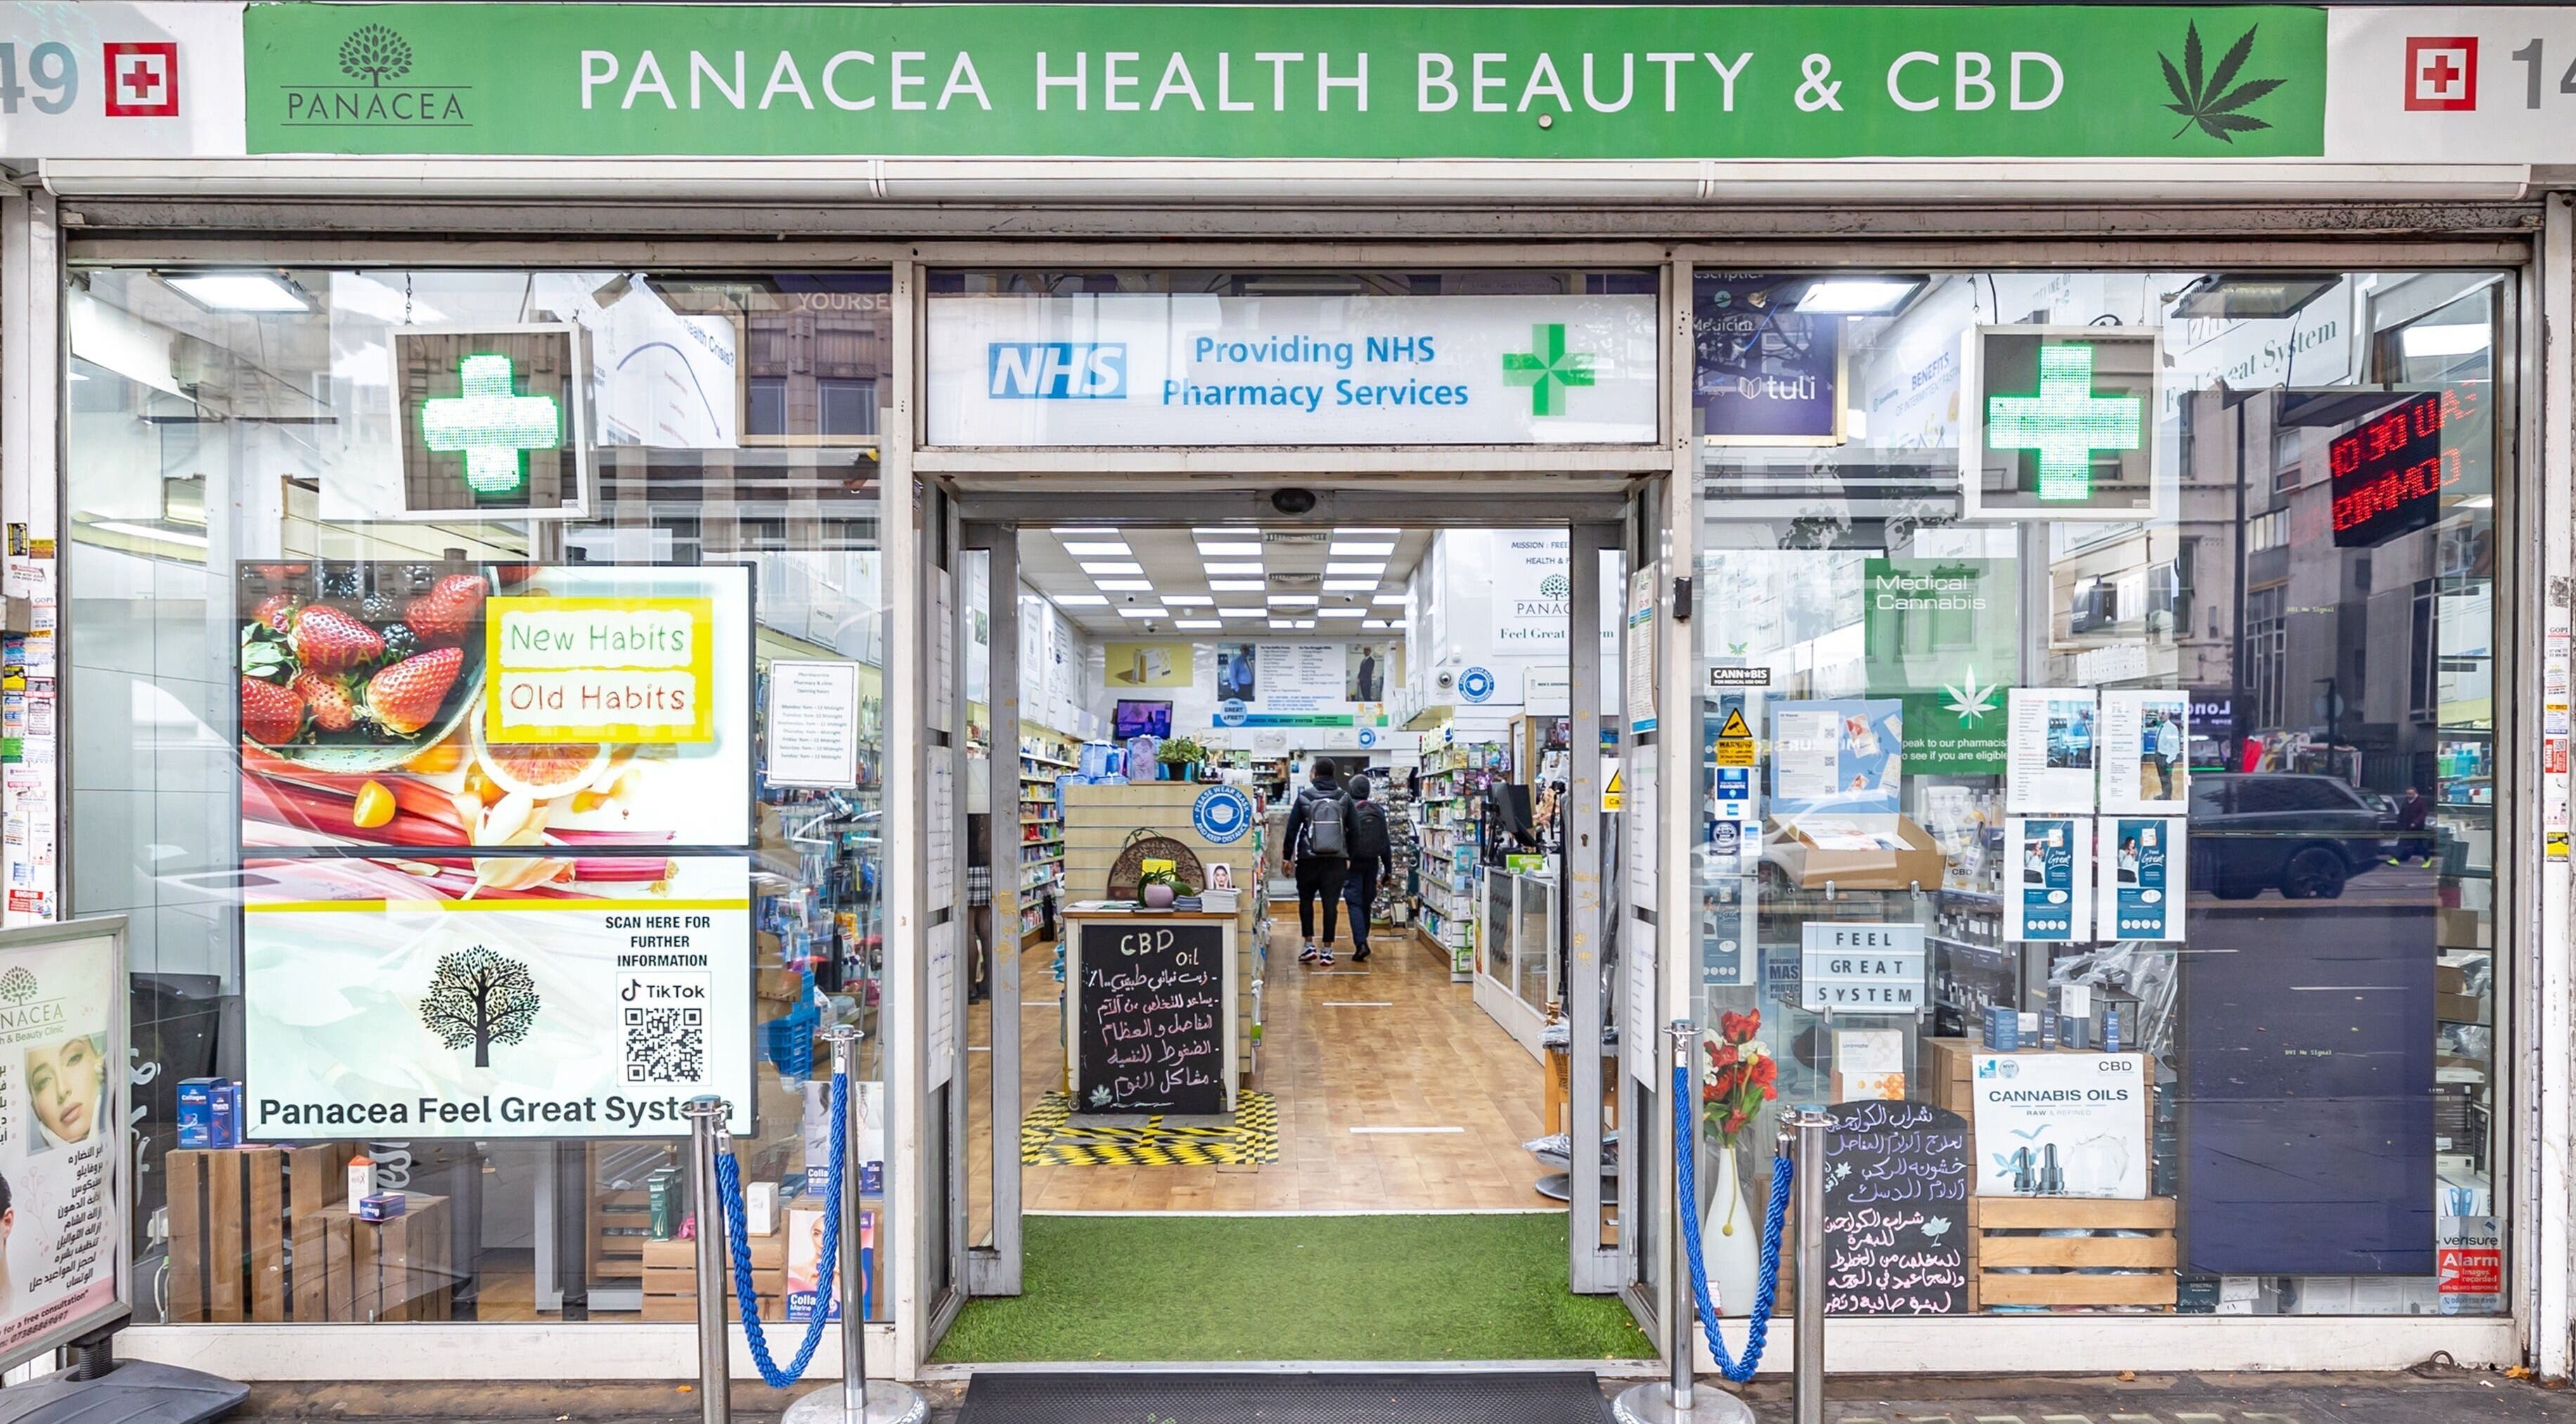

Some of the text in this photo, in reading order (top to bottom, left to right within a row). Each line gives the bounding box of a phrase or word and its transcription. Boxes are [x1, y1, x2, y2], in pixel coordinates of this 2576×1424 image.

[581, 50, 2064, 112] PANACEA HEALTH BEAUTY & CBD
[288, 92, 465, 120] PANACEA
[1196, 336, 1436, 370] Providing NHS
[991, 346, 1123, 396] NHS
[1912, 352, 1949, 390] BENEFITS
[1767, 375, 1815, 400] tuli
[1162, 380, 1469, 413] Pharmacy Services
[1876, 575, 1967, 590] Medical
[1876, 595, 1986, 609] Cannabis
[512, 623, 685, 652] New Habits
[1501, 628, 1565, 639] Feel Great
[510, 683, 685, 710] Old Habits
[1902, 739, 1925, 752] peak
[1957, 739, 2008, 752] pharmacis
[1929, 751, 1936, 760] if
[1938, 753, 1955, 762] you
[1194, 787, 1250, 813] PLEASE WEAR MASK
[1196, 822, 1249, 843] AND KEEP DISTANCE
[605, 917, 710, 928] SCAN HERE FOR
[631, 936, 690, 947] FURTHER
[1121, 929, 1174, 957] CBD
[1836, 932, 1892, 946] FEEL
[617, 954, 707, 966] INFORMATION
[1176, 948, 1199, 966] Oil
[1770, 965, 1800, 980] MAS
[1831, 960, 1903, 974] GREAT
[646, 985, 705, 998] TikTok
[1819, 988, 1912, 1002] SYSTEM
[15, 1030, 43, 1042] Beauty
[2099, 1061, 2132, 1072] CBD
[1115, 1071, 1154, 1102] النوم
[1990, 1089, 2128, 1102] CANNABIS OILS
[259, 1096, 733, 1129] Panacea Feel Great Syste
[1889, 1104, 1933, 1130] شراب
[808, 1168, 829, 1177] Colla
[2442, 1253, 2498, 1267] Alarm
[1876, 1269, 1890, 1290] في
[790, 1294, 816, 1305] Colla
[4, 1324, 15, 1335] for
[24, 1313, 39, 1325] free
